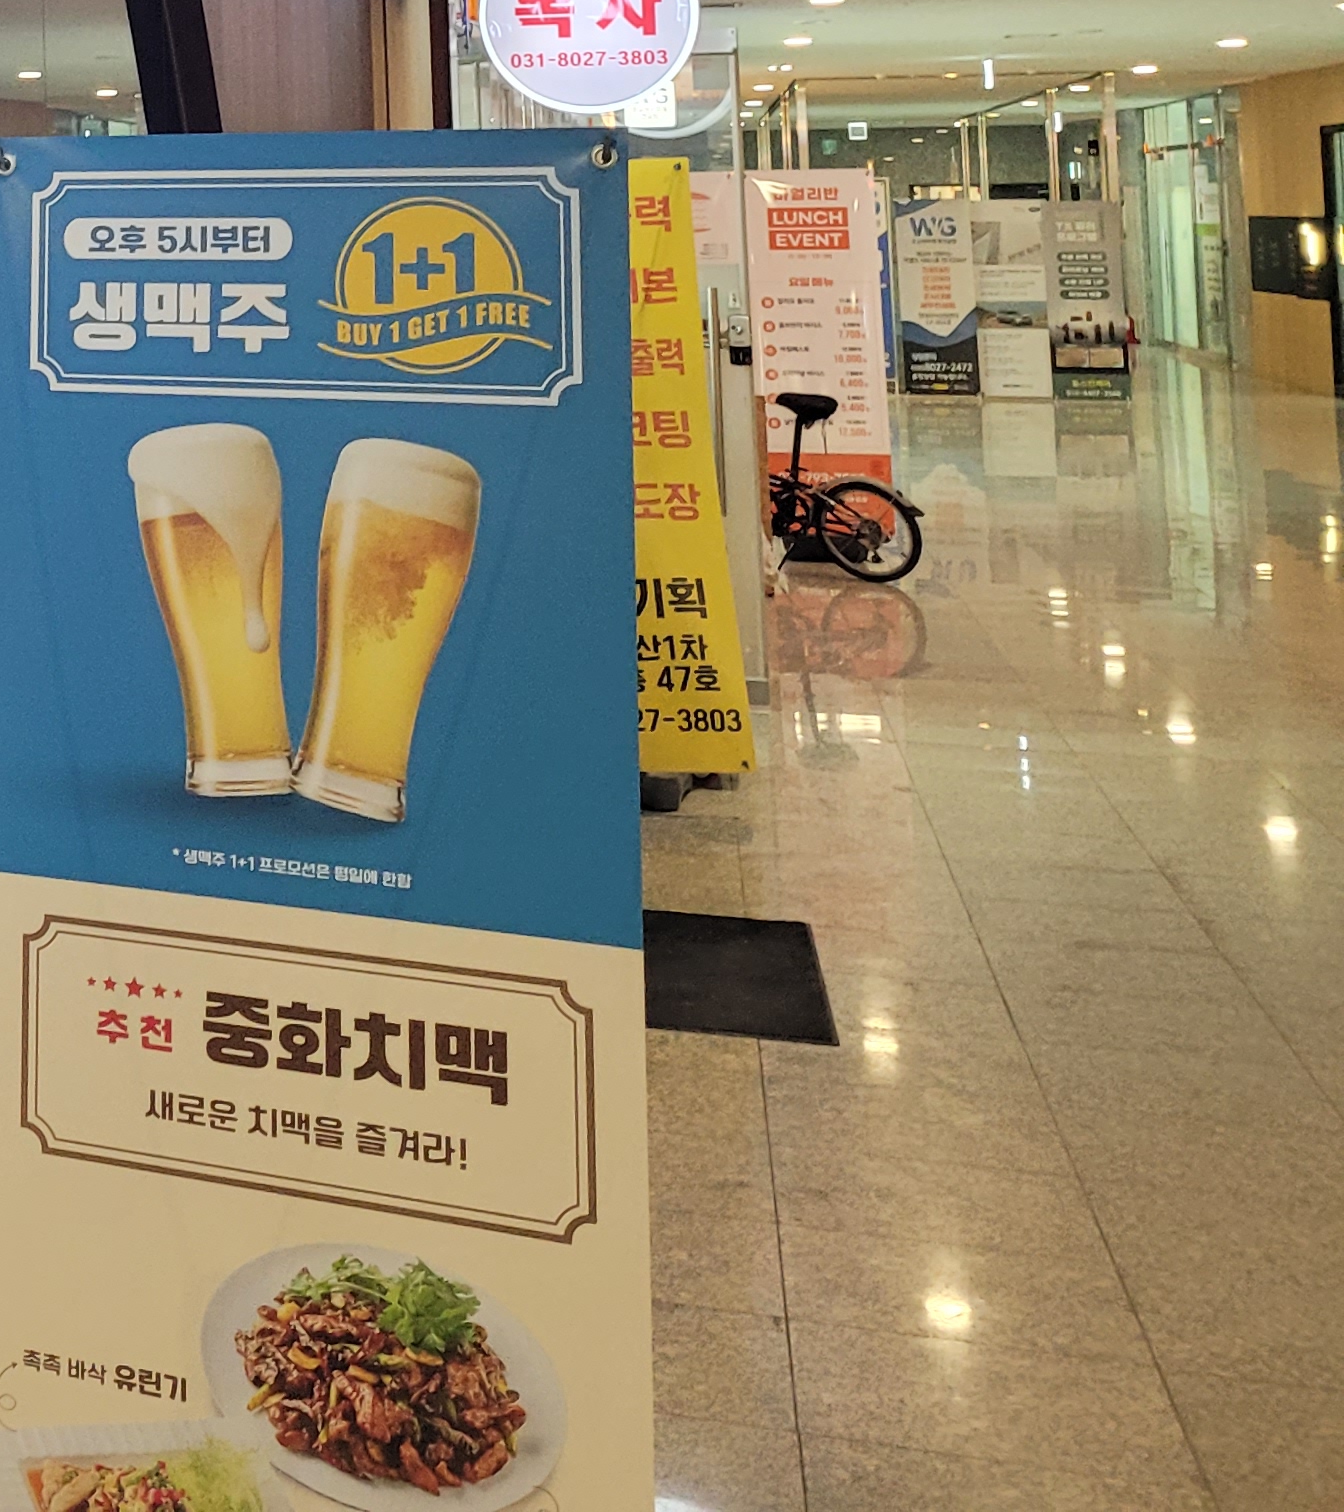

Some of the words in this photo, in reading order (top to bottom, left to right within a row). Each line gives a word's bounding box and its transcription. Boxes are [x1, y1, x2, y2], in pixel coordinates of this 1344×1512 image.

[510, 49, 669, 69] 031-8027-3803
[629, 195, 672, 233] 력
[772, 210, 844, 226] LUNCH
[88, 225, 147, 254] 오후
[157, 225, 271, 254] 5시부터
[775, 232, 843, 248] EVENT
[362, 231, 476, 306] 1+1
[630, 266, 678, 305] 본
[69, 280, 291, 354] 생맥주
[336, 319, 382, 347] BUY
[389, 320, 400, 344] 1
[407, 308, 450, 339] GET
[456, 305, 468, 328] 1
[475, 301, 531, 328] FREE
[634, 482, 701, 522] 도장
[635, 577, 708, 619] 기획
[657, 665, 721, 693] 47호
[183, 848, 226, 867] 생맥주
[229, 853, 256, 872] 1+1
[258, 856, 330, 881] 프로모션은
[334, 864, 379, 886] 평일에
[96, 1008, 174, 1054] 추천
[202, 990, 509, 1107] 중화치맥
[144, 1088, 239, 1133] 새로운
[247, 1104, 345, 1151] 치맥을
[355, 1120, 468, 1171] 즐겨라!
[68, 1356, 108, 1387] 바삭
[113, 1363, 188, 1404] 유린기
